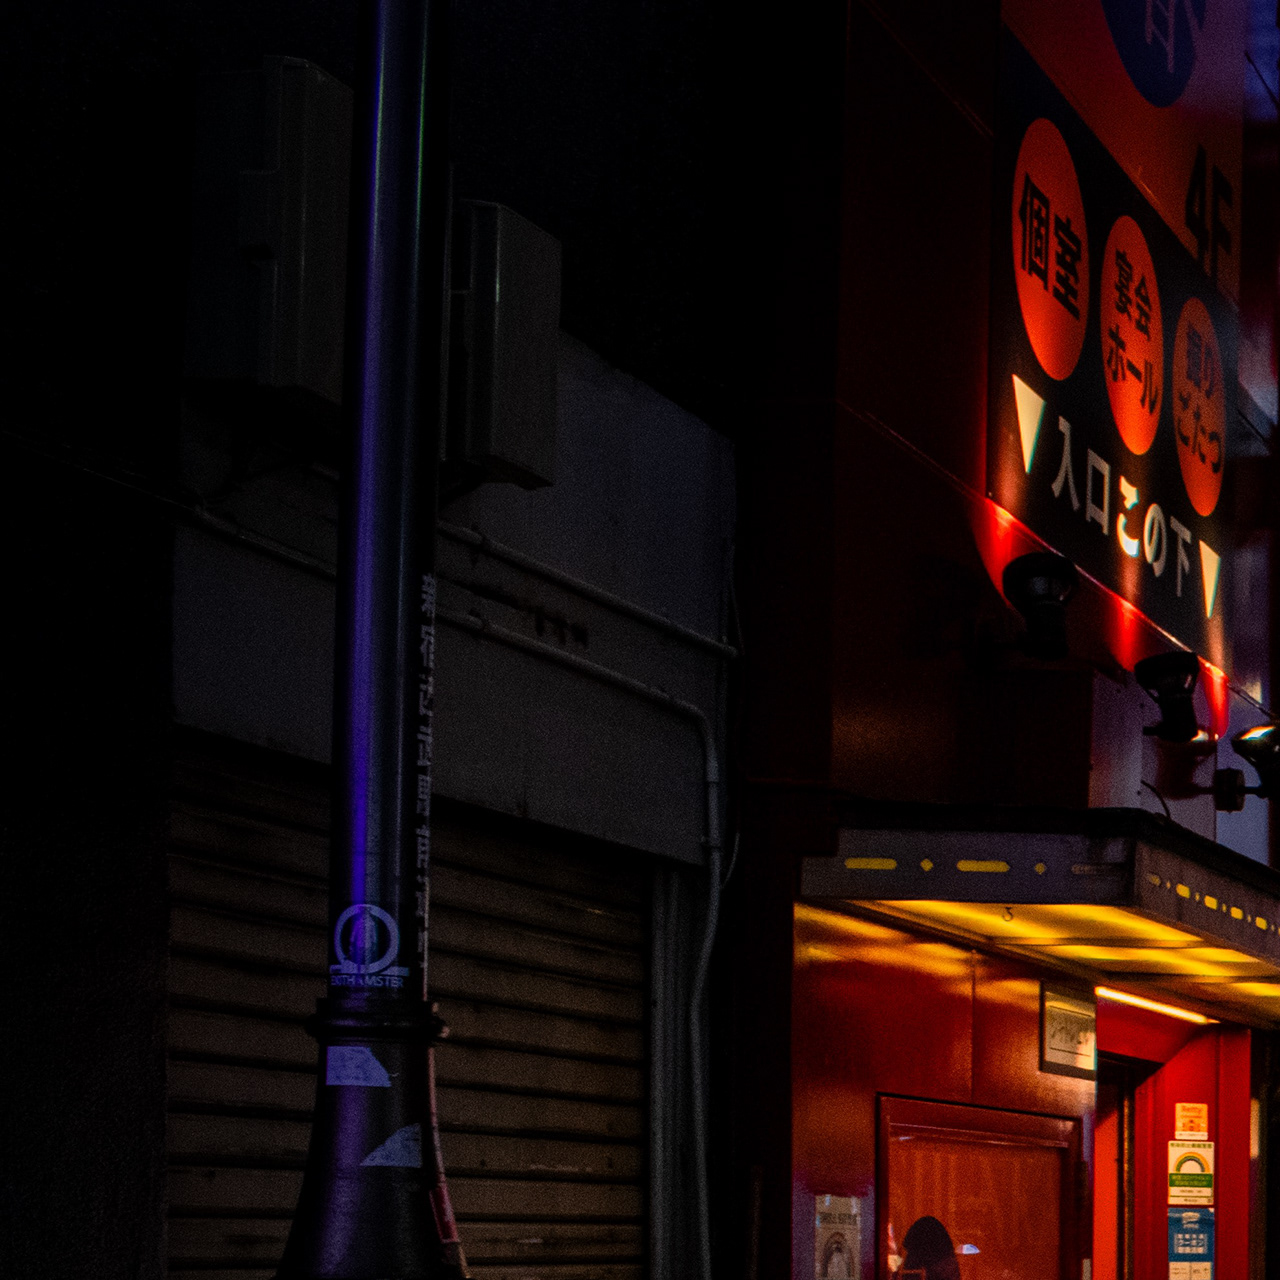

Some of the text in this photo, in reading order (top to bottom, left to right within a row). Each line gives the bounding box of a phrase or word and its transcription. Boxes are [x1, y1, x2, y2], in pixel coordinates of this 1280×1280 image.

[1018, 170, 1083, 321] 個室
[1050, 413, 1193, 600] 入口この下
